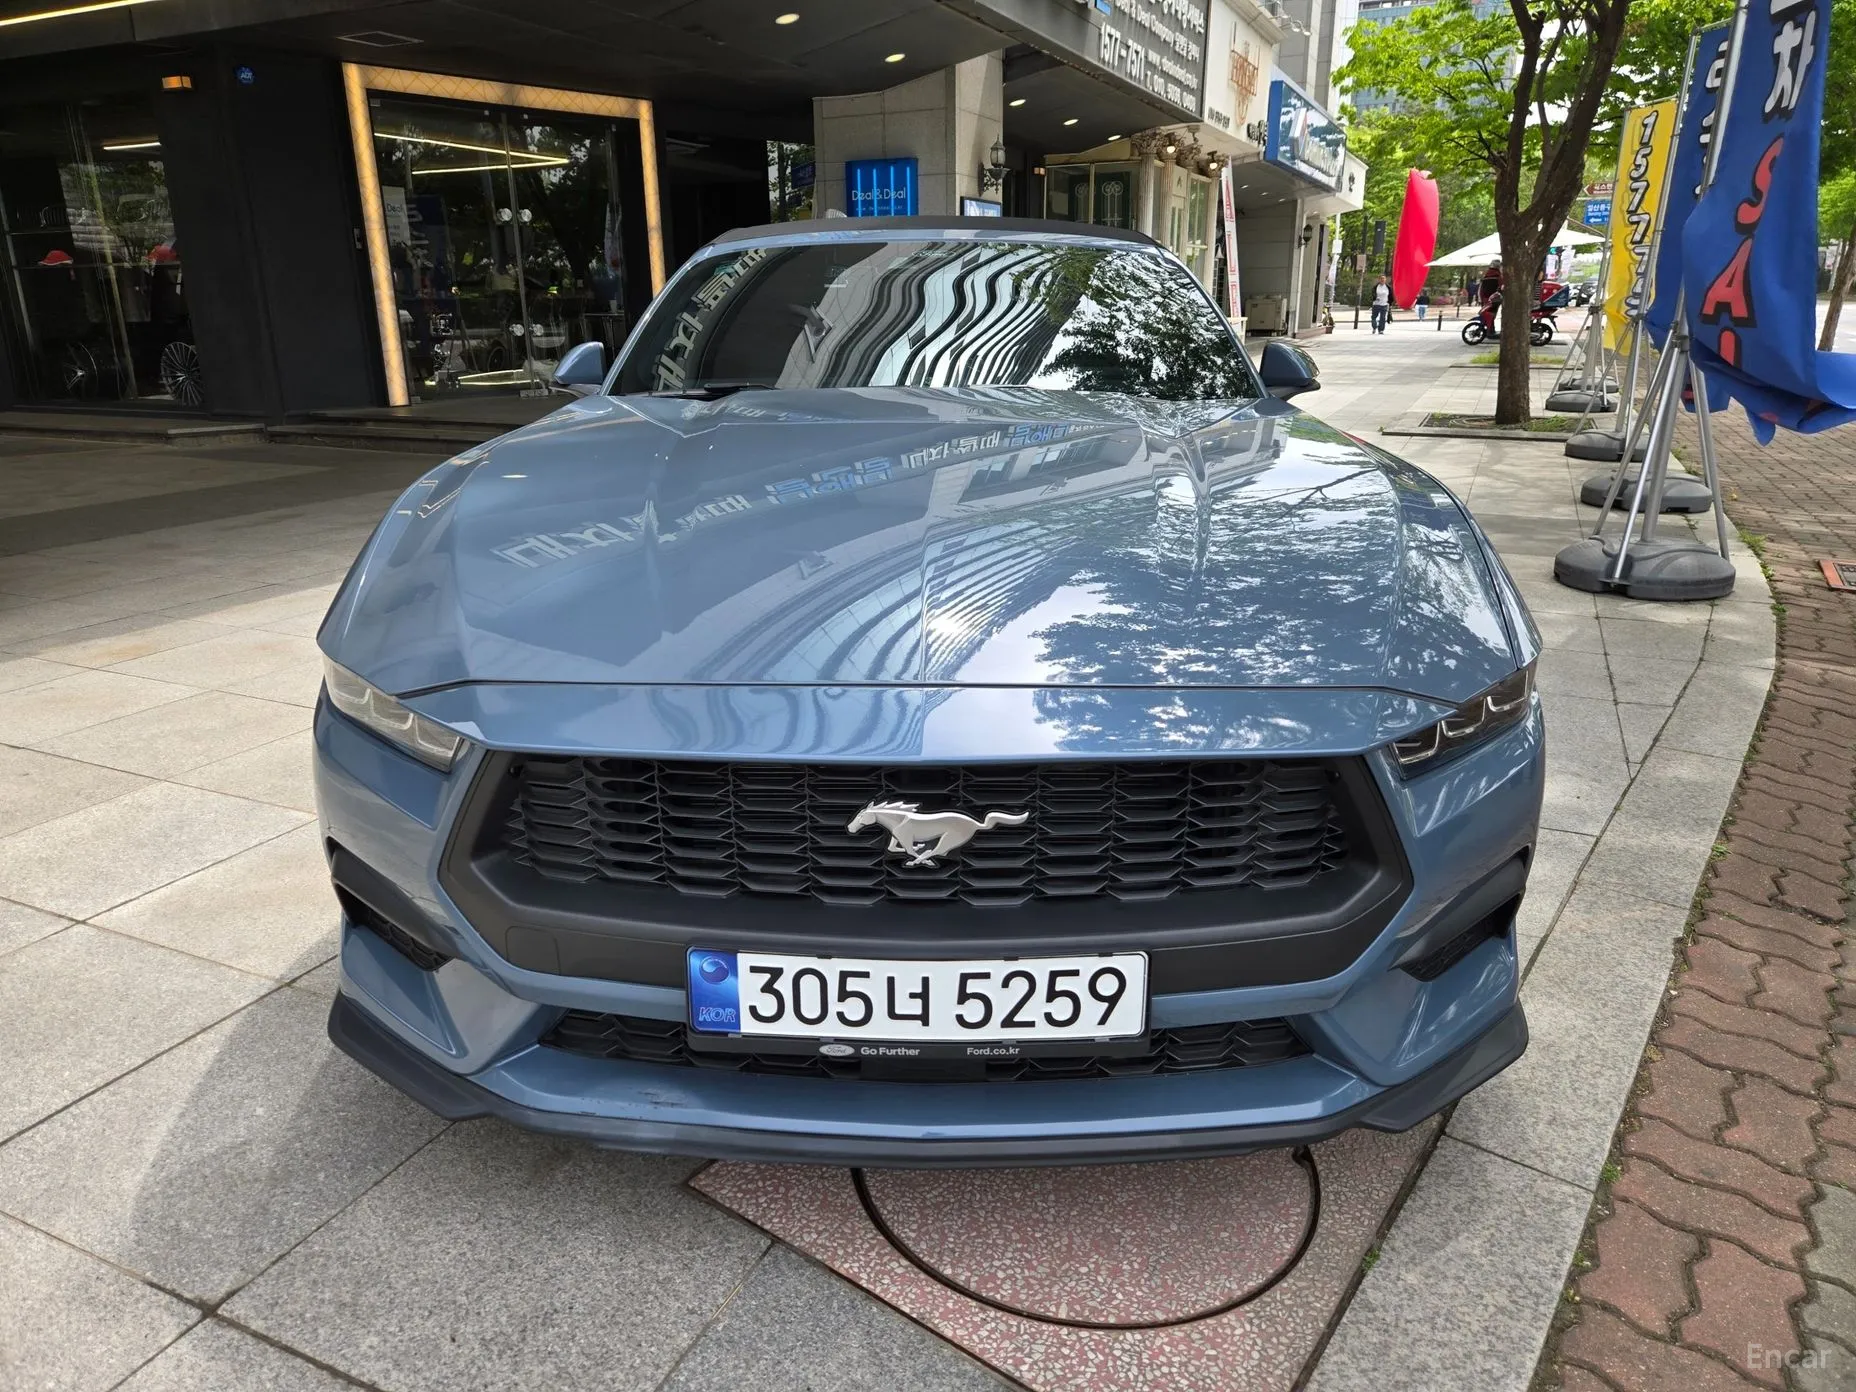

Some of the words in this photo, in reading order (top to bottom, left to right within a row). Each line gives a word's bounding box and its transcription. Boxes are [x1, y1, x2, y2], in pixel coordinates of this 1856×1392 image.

[1101, 21, 1145, 81] 1577-7571
[1764, 0, 1817, 117] 차
[749, 965, 930, 1028] 305너
[955, 966, 1127, 1030] 5259
[699, 1006, 737, 1023] KOR
[823, 1044, 851, 1057] Ford
[860, 1047, 876, 1056] Go
[879, 1047, 921, 1056] Further
[966, 1046, 1021, 1056] Ford.co.kr
